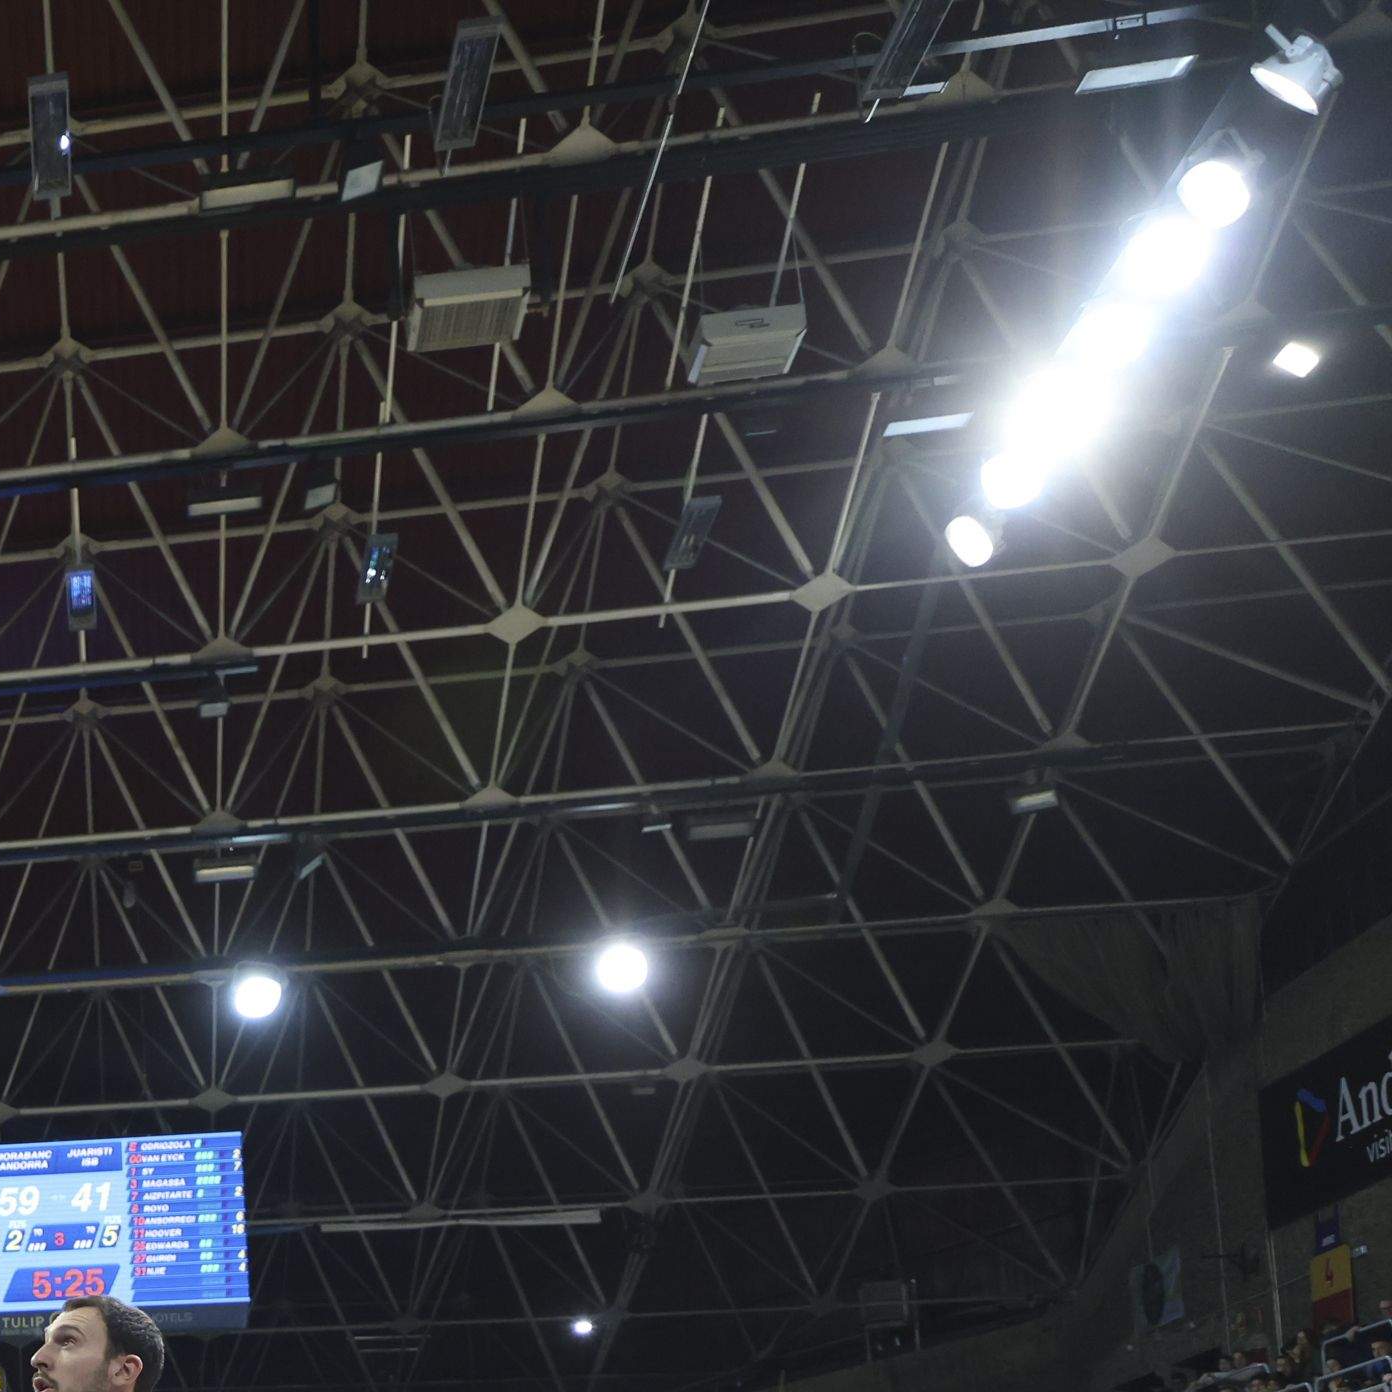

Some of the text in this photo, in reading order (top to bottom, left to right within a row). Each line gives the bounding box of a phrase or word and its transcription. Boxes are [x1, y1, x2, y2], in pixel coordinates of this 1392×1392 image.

[67, 1147, 114, 1158] JUARISTI
[0, 1160, 48, 1171] ANDORRA
[70, 1181, 112, 1213] 41
[5, 1229, 23, 1251] 2
[102, 1224, 119, 1247] 5
[31, 1267, 105, 1300] 5:25
[2, 1314, 44, 1330] TULIP
